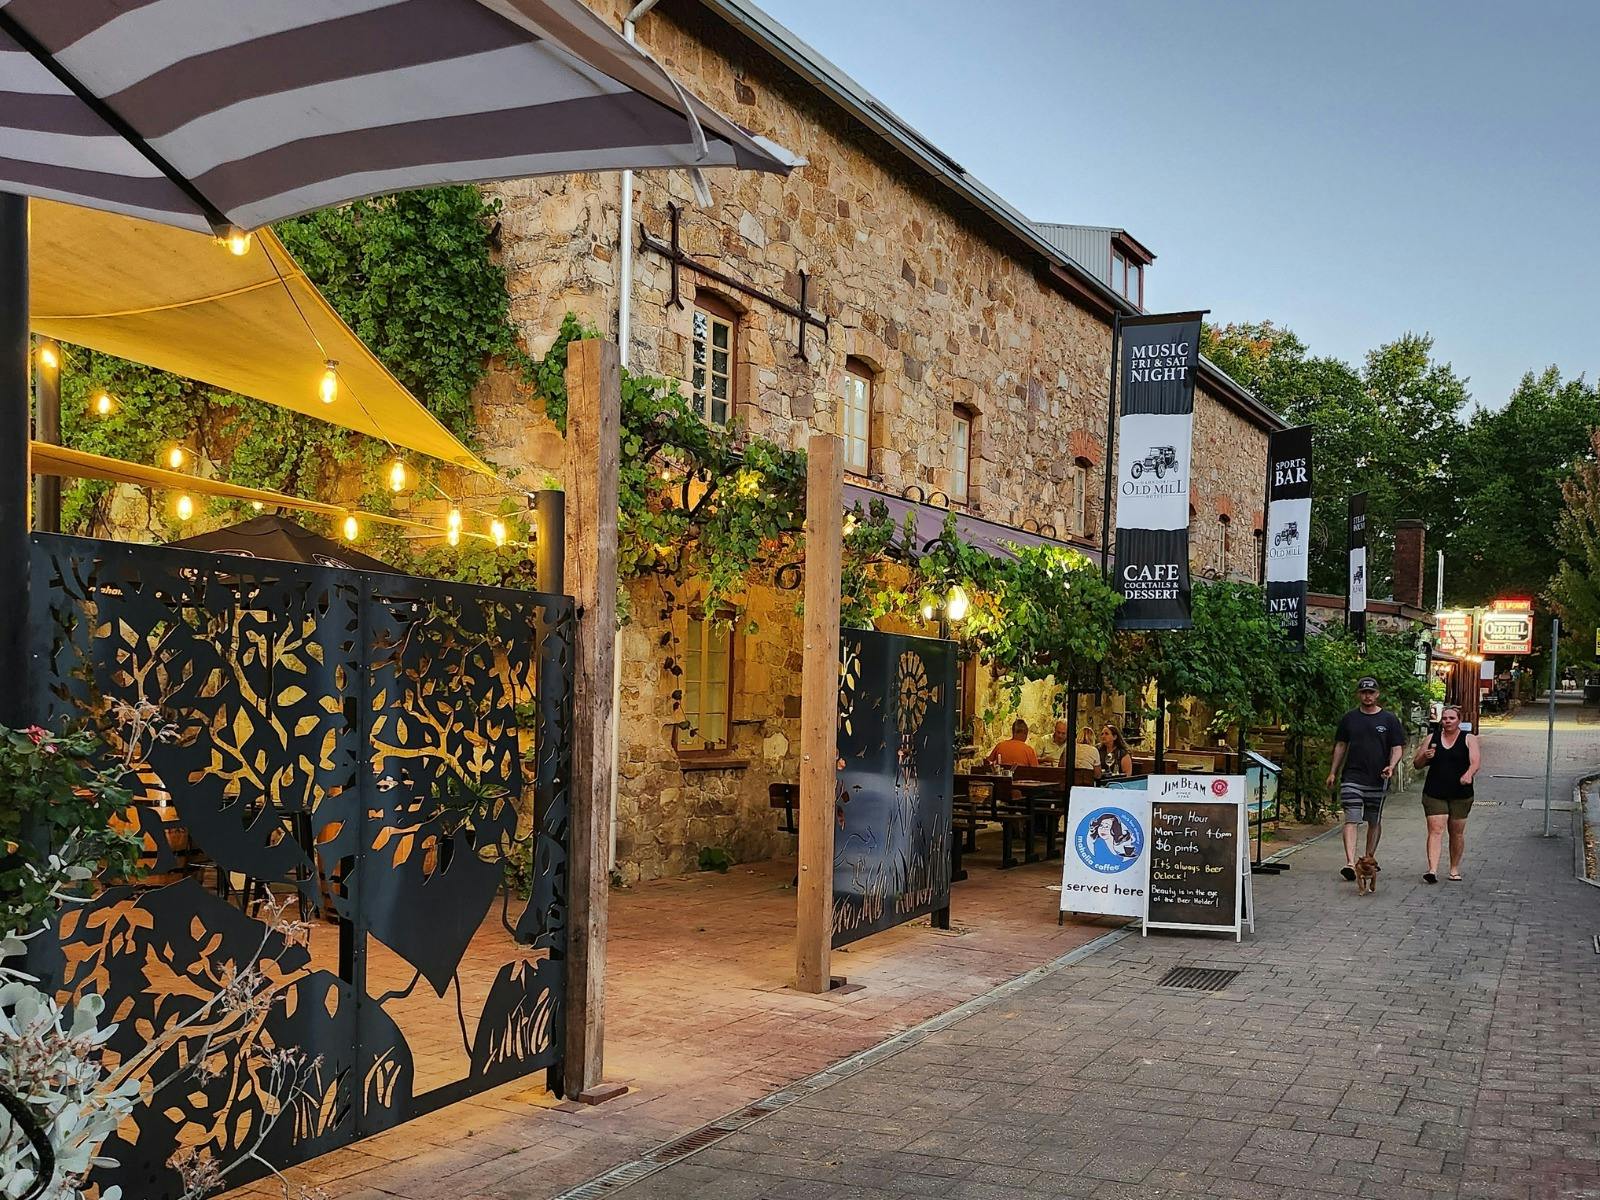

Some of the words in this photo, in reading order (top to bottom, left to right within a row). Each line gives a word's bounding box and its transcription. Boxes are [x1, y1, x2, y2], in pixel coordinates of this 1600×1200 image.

[1131, 342, 1189, 359] MUSIC
[1131, 359, 1151, 369] FRI
[1154, 358, 1163, 367] &
[1166, 356, 1188, 367] SAT
[1130, 366, 1189, 383] NIGHT
[1275, 457, 1306, 471] SPORTS
[1274, 466, 1309, 487] BAR
[1122, 481, 1151, 496] OLD
[1154, 479, 1187, 494] MILL
[1123, 564, 1180, 581] CAFE
[1124, 581, 1171, 589] COCKTAILS
[1172, 581, 1179, 589] &
[1124, 589, 1180, 600] DESSERT
[1269, 597, 1300, 612] NEW
[1485, 622, 1505, 634] OLD
[1505, 622, 1528, 635] MILL
[1160, 781, 1179, 796] JIM
[1181, 777, 1206, 796] BEAM
[1153, 807, 1183, 826] Happy
[1188, 810, 1209, 823] Hour
[1205, 827, 1232, 839] 4-6pm
[1076, 835, 1094, 865] mahalia
[1094, 863, 1120, 871] coffee
[1155, 837, 1171, 852] $6
[1174, 841, 1199, 856] pints
[1152, 858, 1171, 870] It's
[1174, 861, 1201, 873] always
[1204, 864, 1225, 873] Beer
[1066, 881, 1109, 894] served
[1114, 883, 1144, 897] here
[1151, 884, 1176, 898] Beauty
[1195, 888, 1205, 896] the
[1207, 890, 1218, 899] eye
